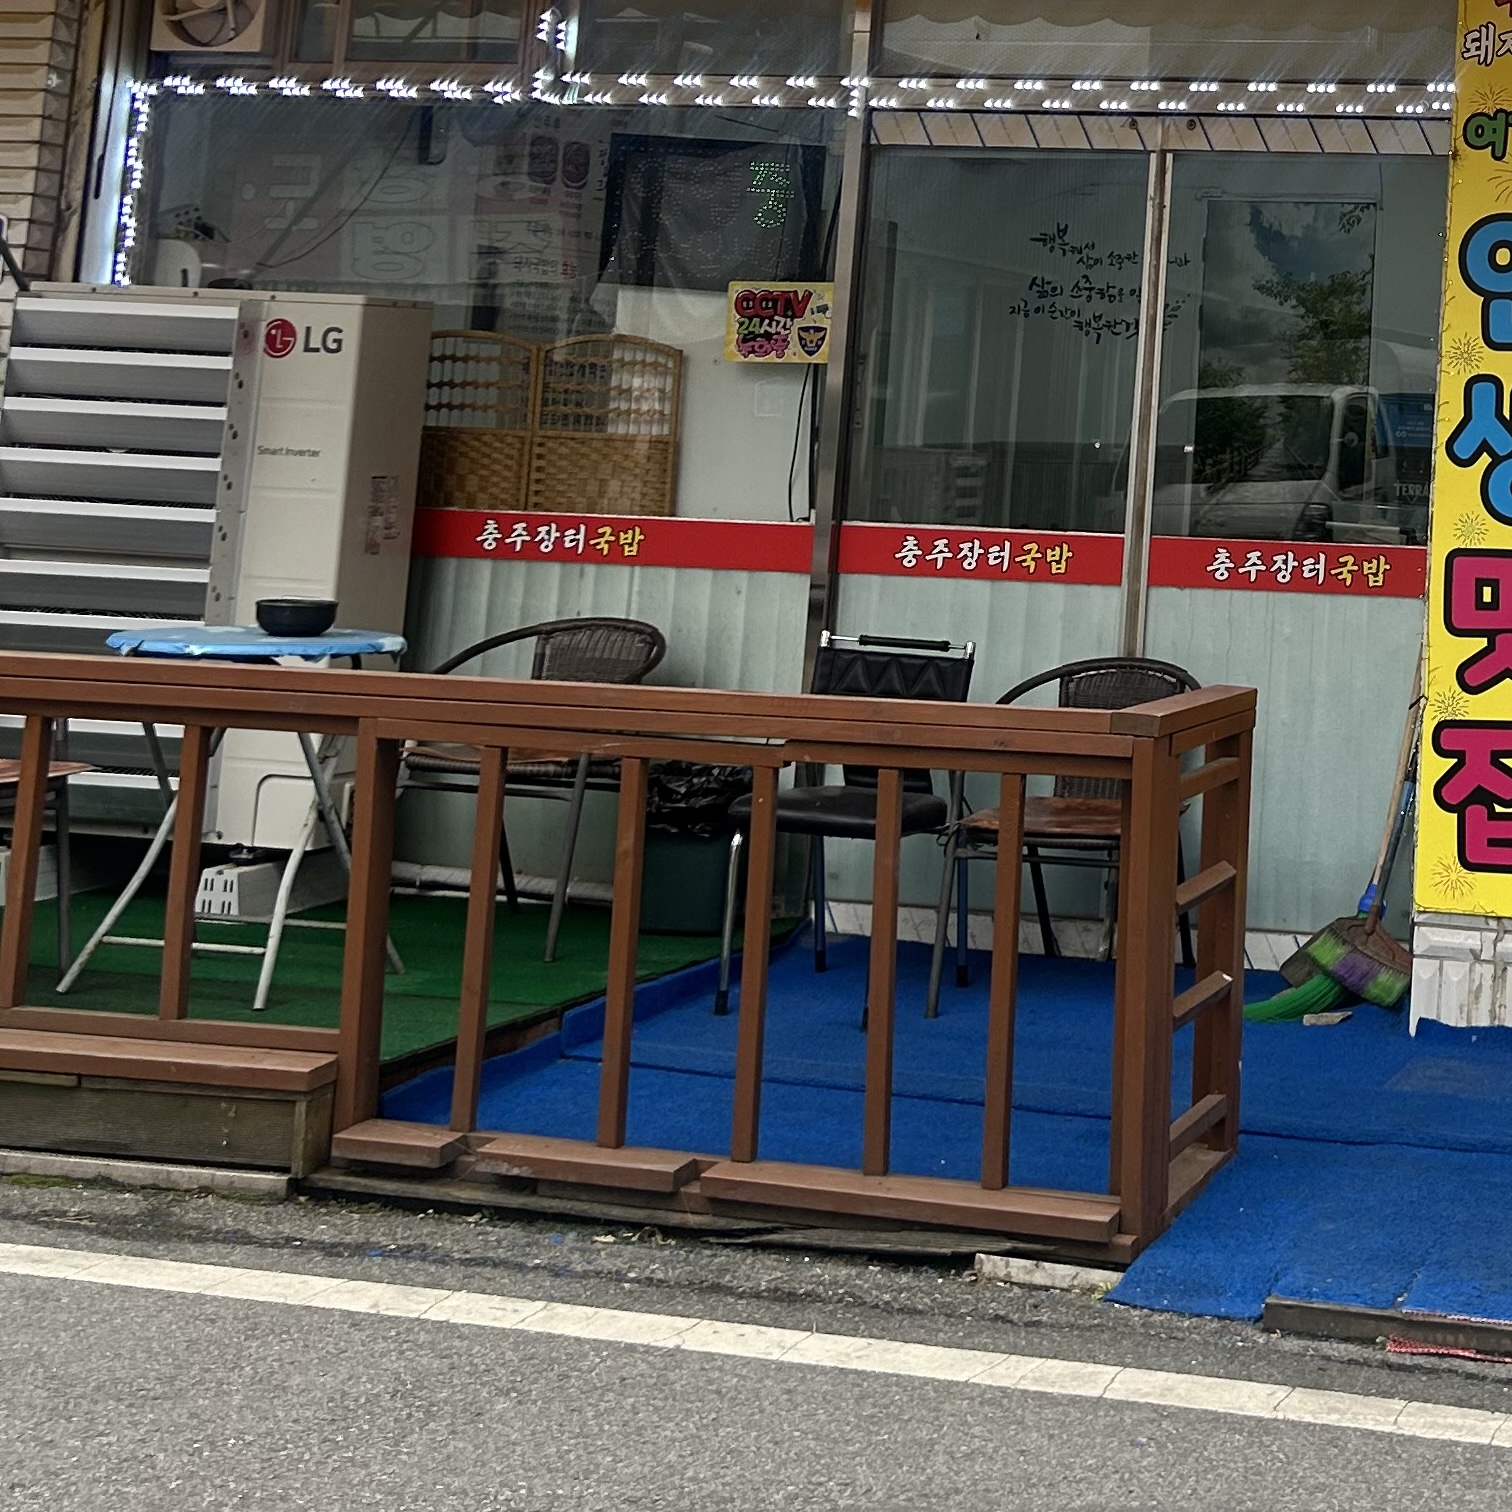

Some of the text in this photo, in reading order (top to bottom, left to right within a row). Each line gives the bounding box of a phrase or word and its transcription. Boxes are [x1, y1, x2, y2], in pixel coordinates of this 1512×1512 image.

[734, 288, 814, 320] CCTV
[302, 326, 343, 354] LG
[736, 316, 793, 335] 24시간
[257, 445, 284, 457] Smart
[475, 518, 645, 557] 충주장터국밥
[894, 535, 1074, 575] 충주장터국밥
[1206, 547, 1392, 589] 충주장터국밥
